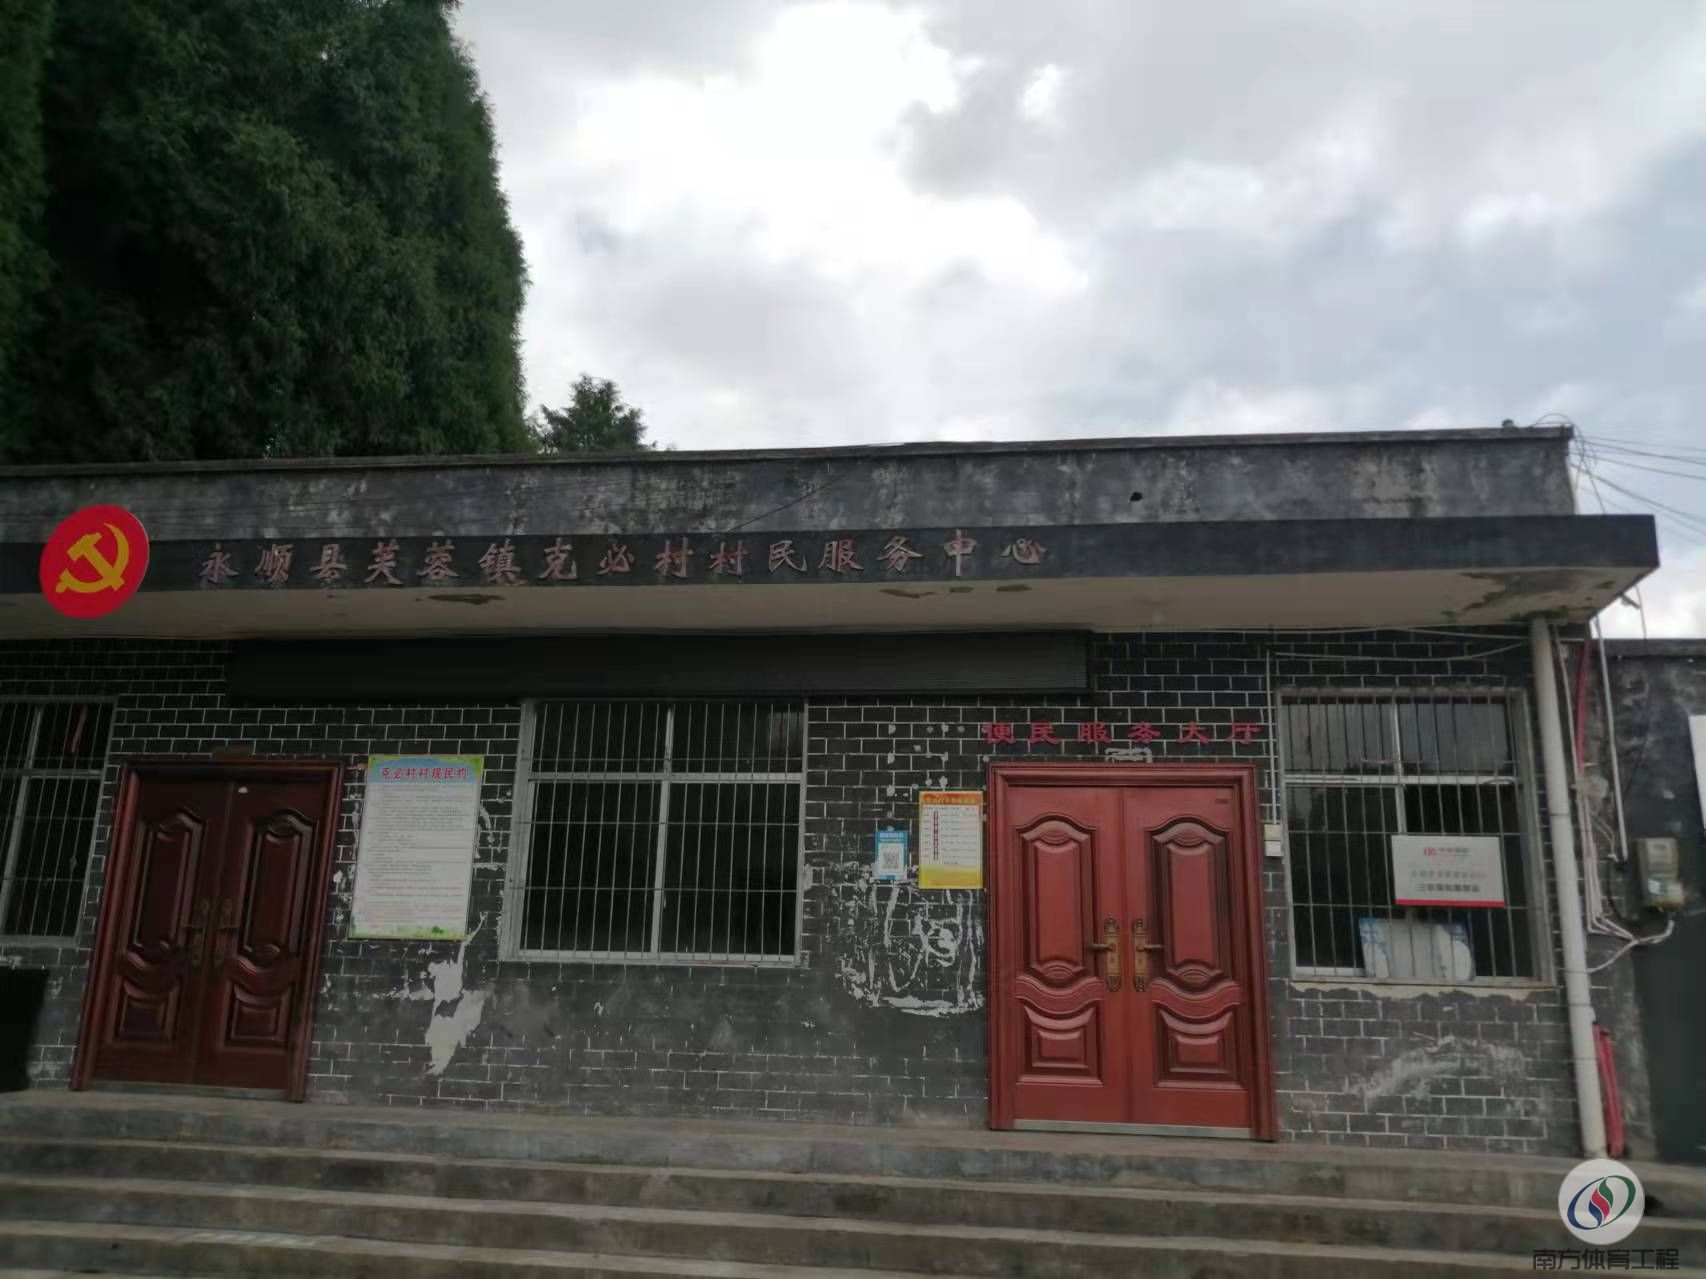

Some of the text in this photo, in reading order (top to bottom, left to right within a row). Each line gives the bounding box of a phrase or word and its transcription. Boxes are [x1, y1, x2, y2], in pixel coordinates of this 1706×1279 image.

[200, 529, 1047, 586] 永顺县芙蓉镇克必村村民服务中心
[982, 720, 1261, 745] 便民服务大厅
